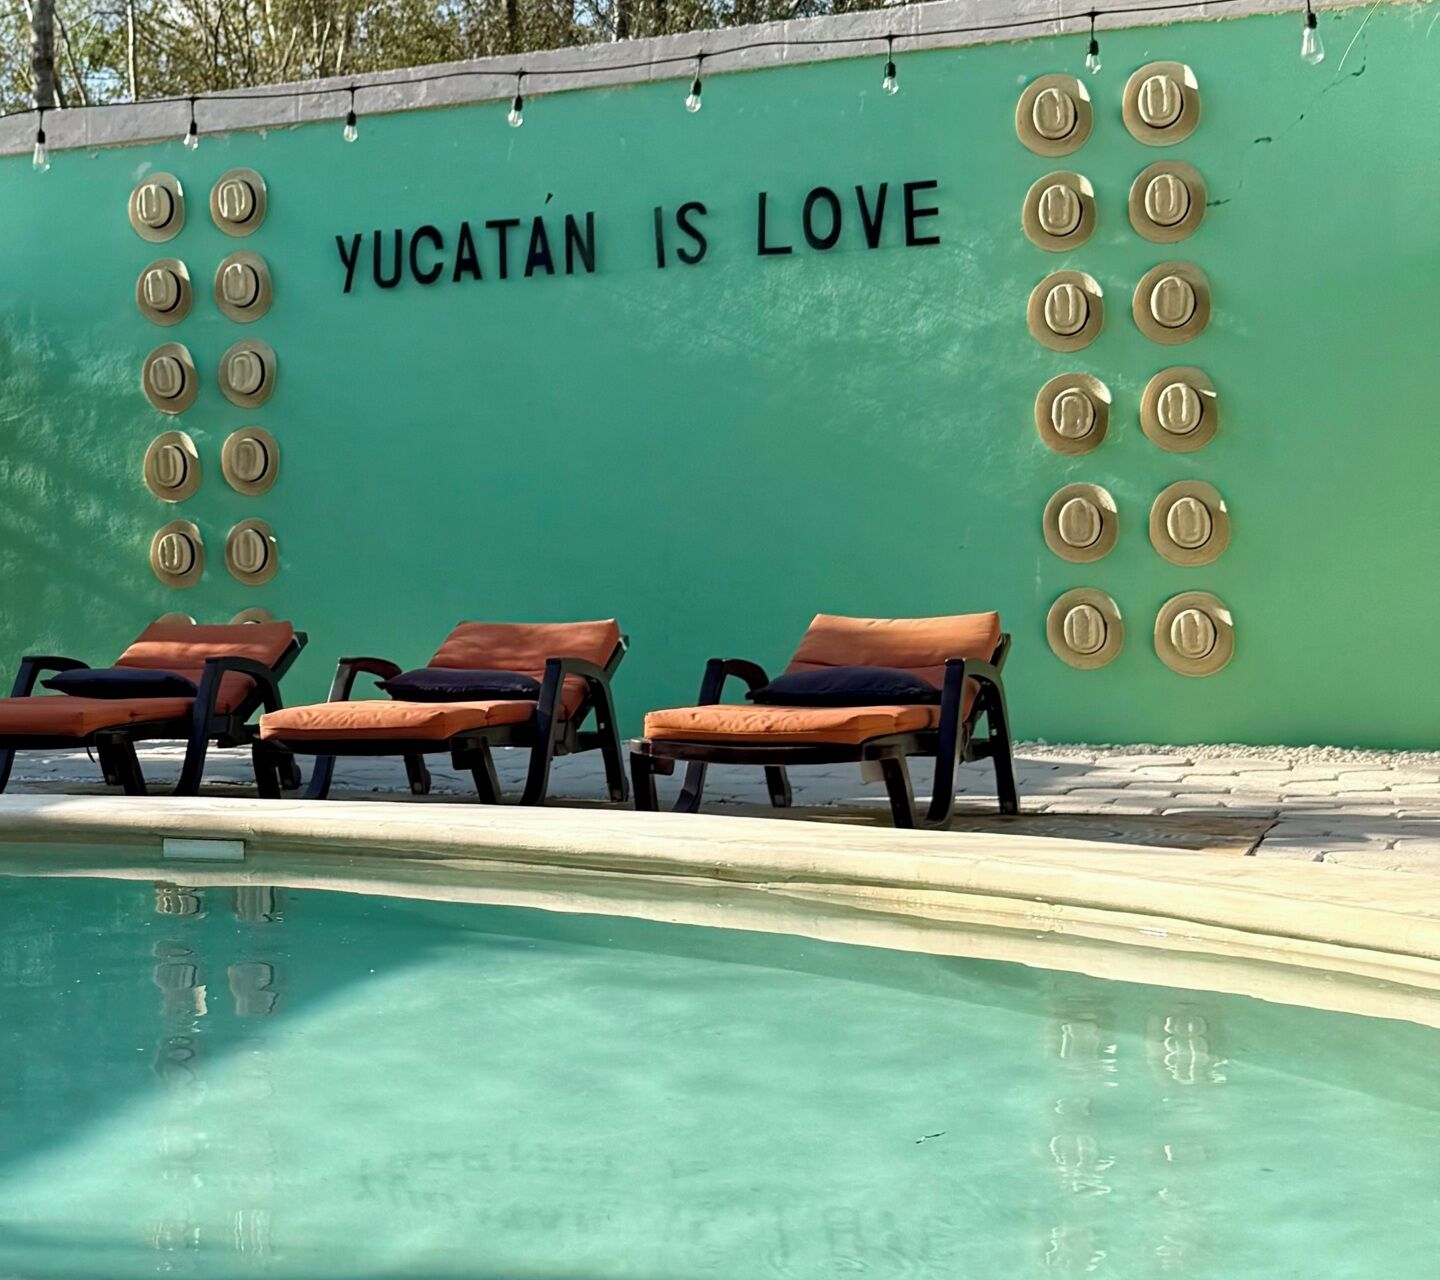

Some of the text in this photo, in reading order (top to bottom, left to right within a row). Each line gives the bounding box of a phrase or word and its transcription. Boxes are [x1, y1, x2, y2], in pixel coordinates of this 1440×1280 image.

[335, 179, 942, 294] YUCATÁN IS LOVE
